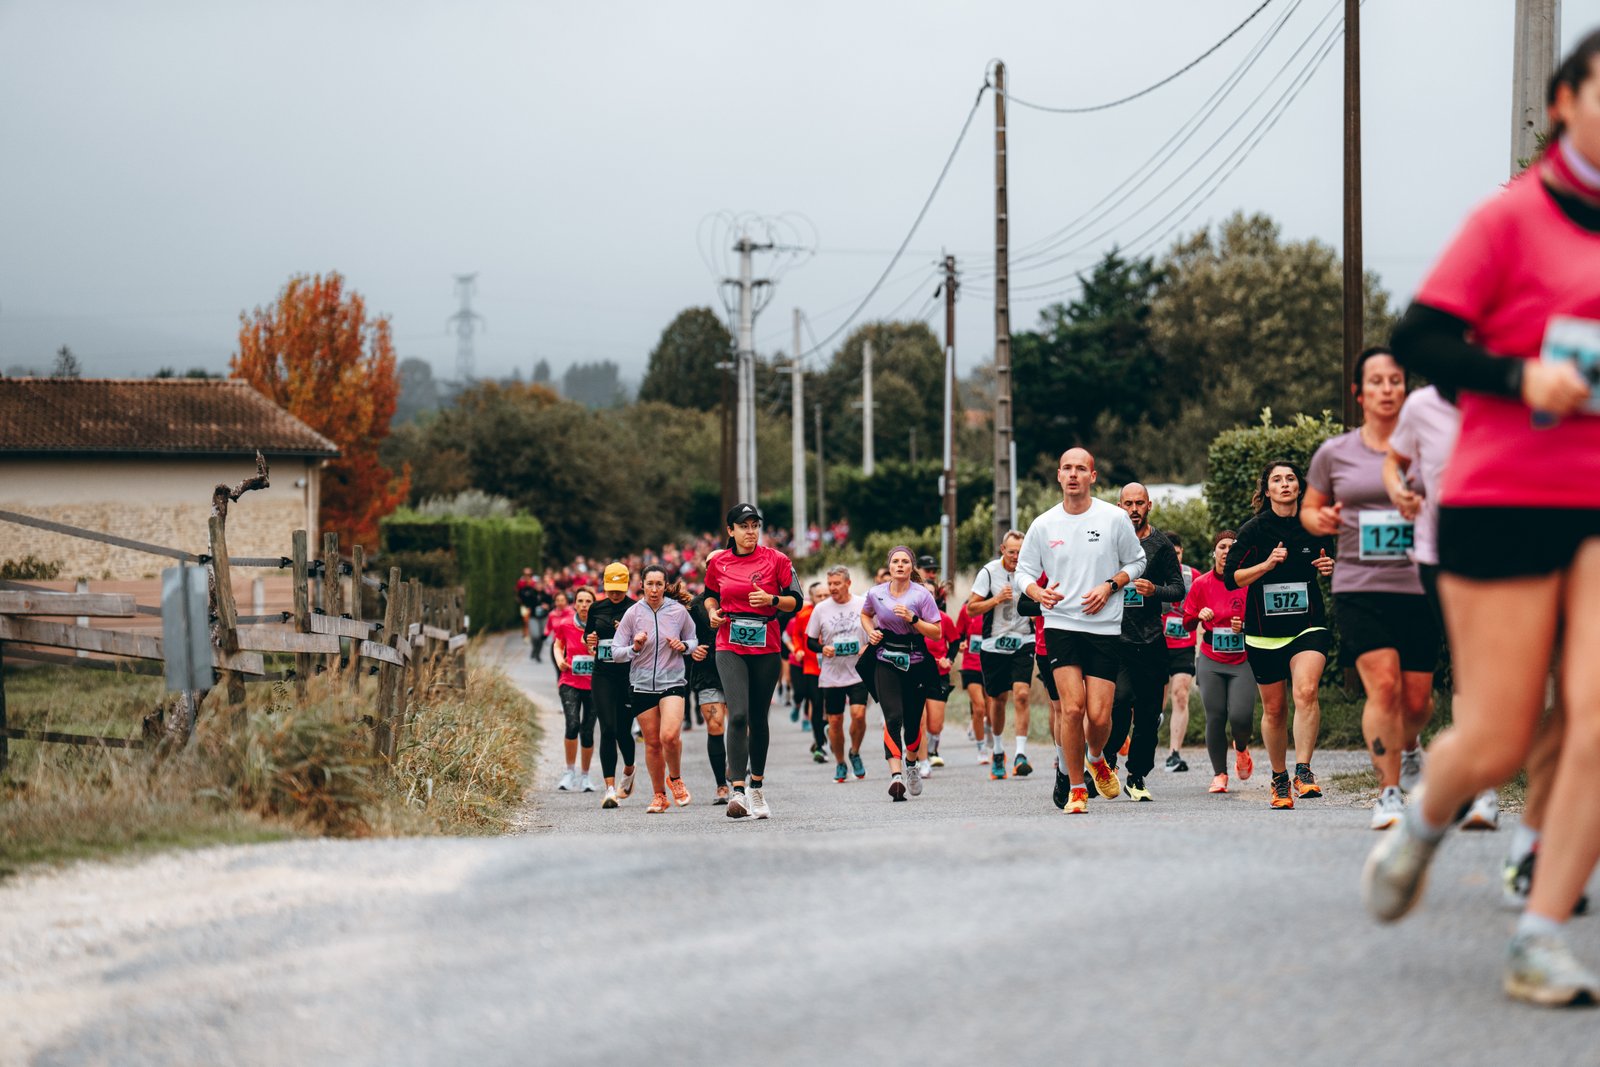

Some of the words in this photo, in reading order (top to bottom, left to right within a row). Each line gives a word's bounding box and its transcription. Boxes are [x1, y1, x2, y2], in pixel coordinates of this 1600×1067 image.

[1273, 592, 1299, 608] 572
[739, 628, 757, 641] 92
[837, 643, 857, 653] 449
[1000, 637, 1017, 650] 624
[1216, 635, 1240, 648] 119
[575, 662, 593, 671] 448
